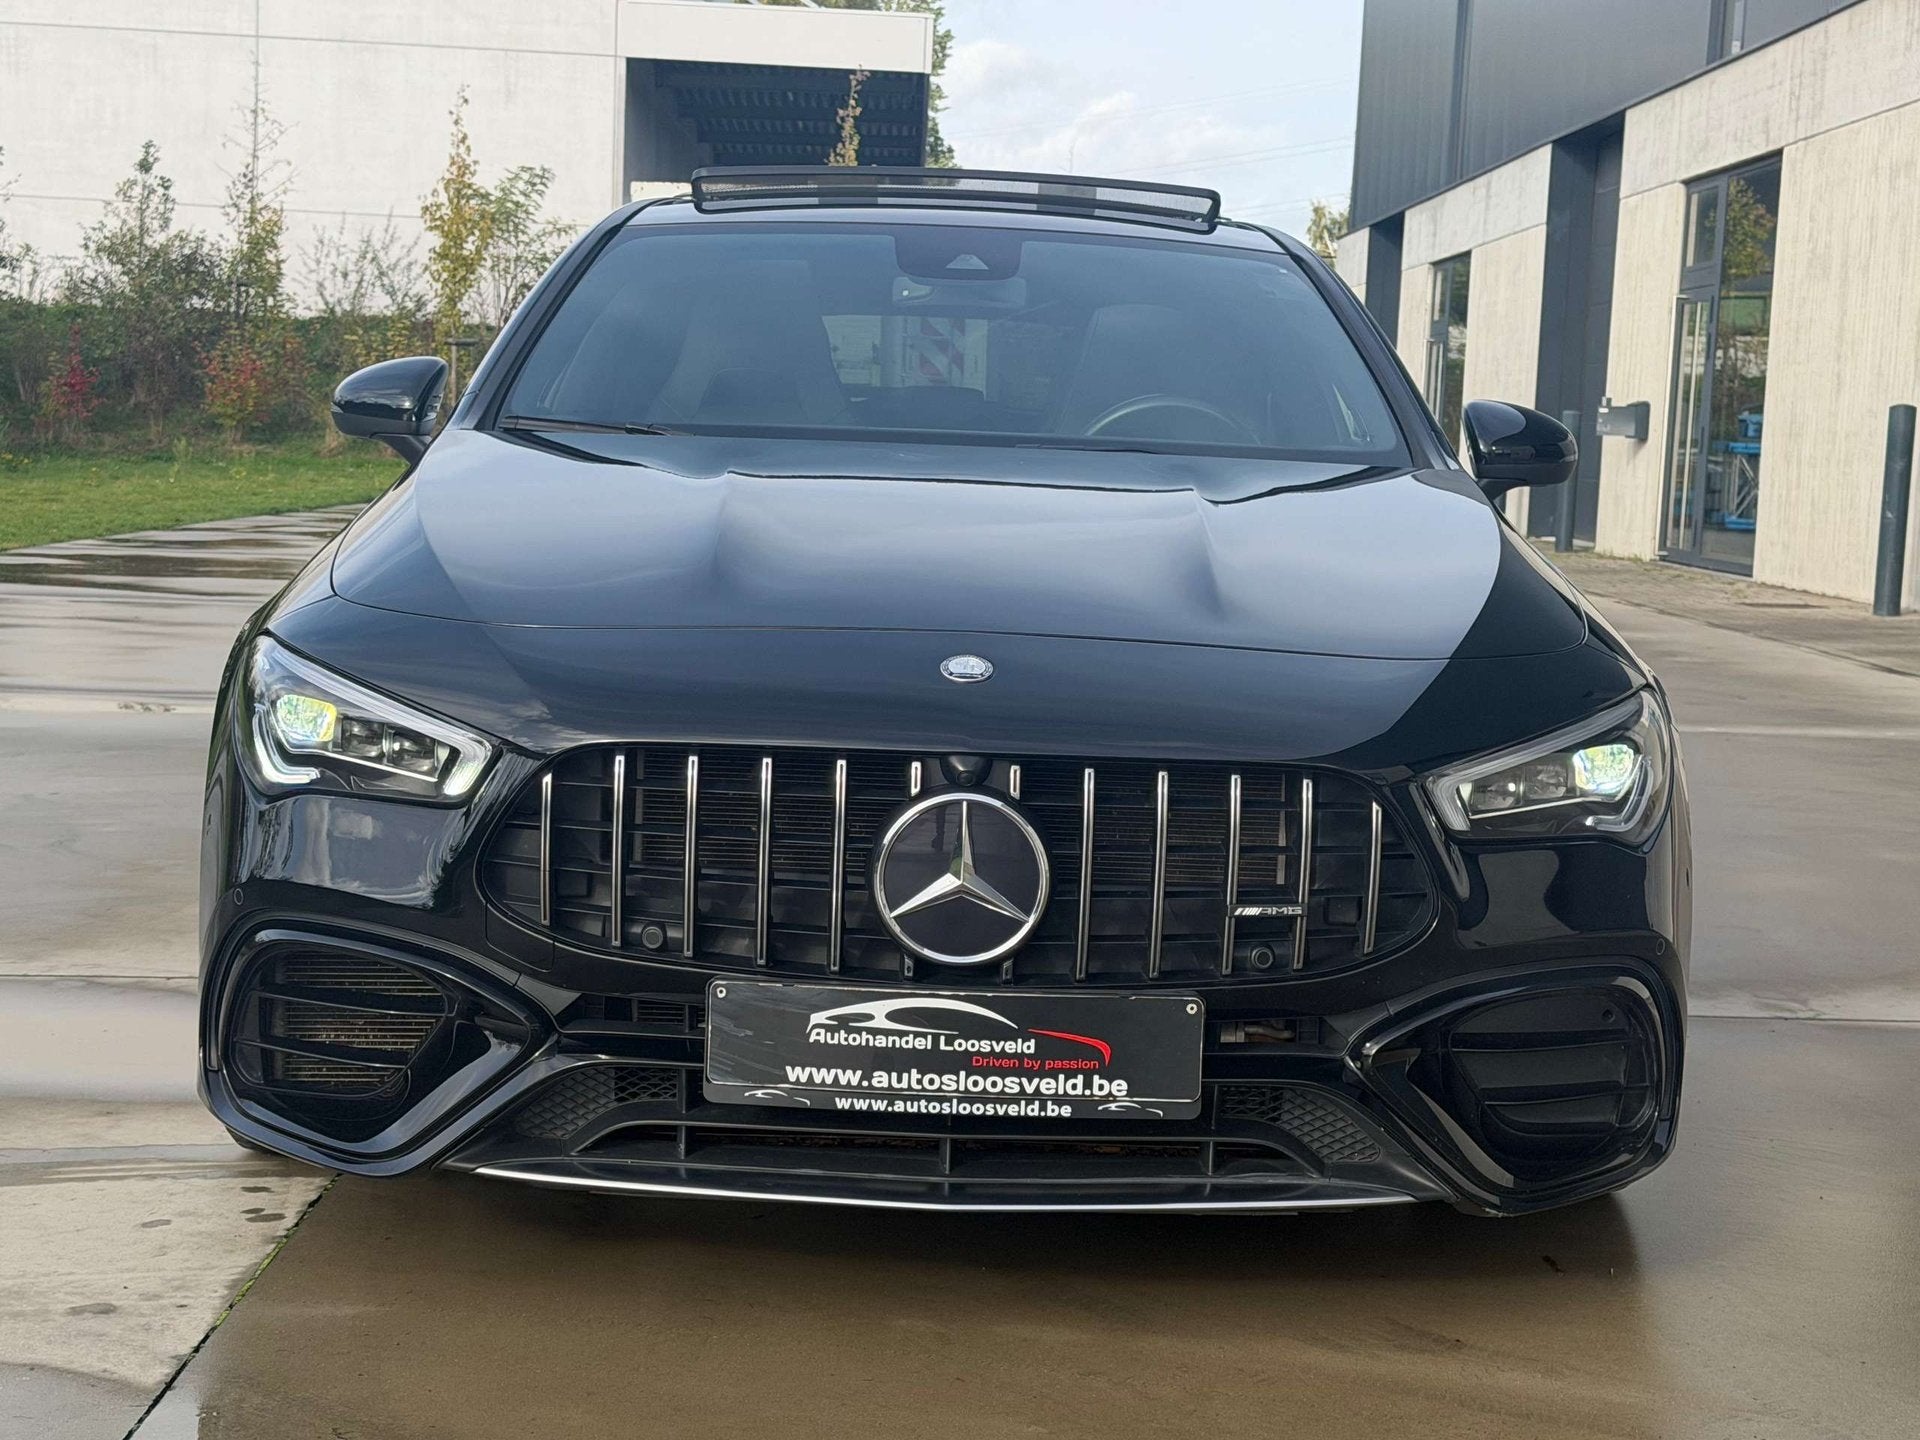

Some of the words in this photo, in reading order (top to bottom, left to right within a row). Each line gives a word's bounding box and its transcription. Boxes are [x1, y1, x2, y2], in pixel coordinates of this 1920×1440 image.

[1259, 906, 1303, 915] AMG
[808, 1028, 933, 1050] Autohandel
[939, 1034, 1035, 1054] Loosveld
[972, 1055, 1019, 1068] Driven
[1023, 1057, 1041, 1070] by
[1045, 1058, 1099, 1071] passion
[785, 1065, 1128, 1097] www.autosloosveld.be
[835, 1096, 1072, 1118] www.autosloosveld.be
